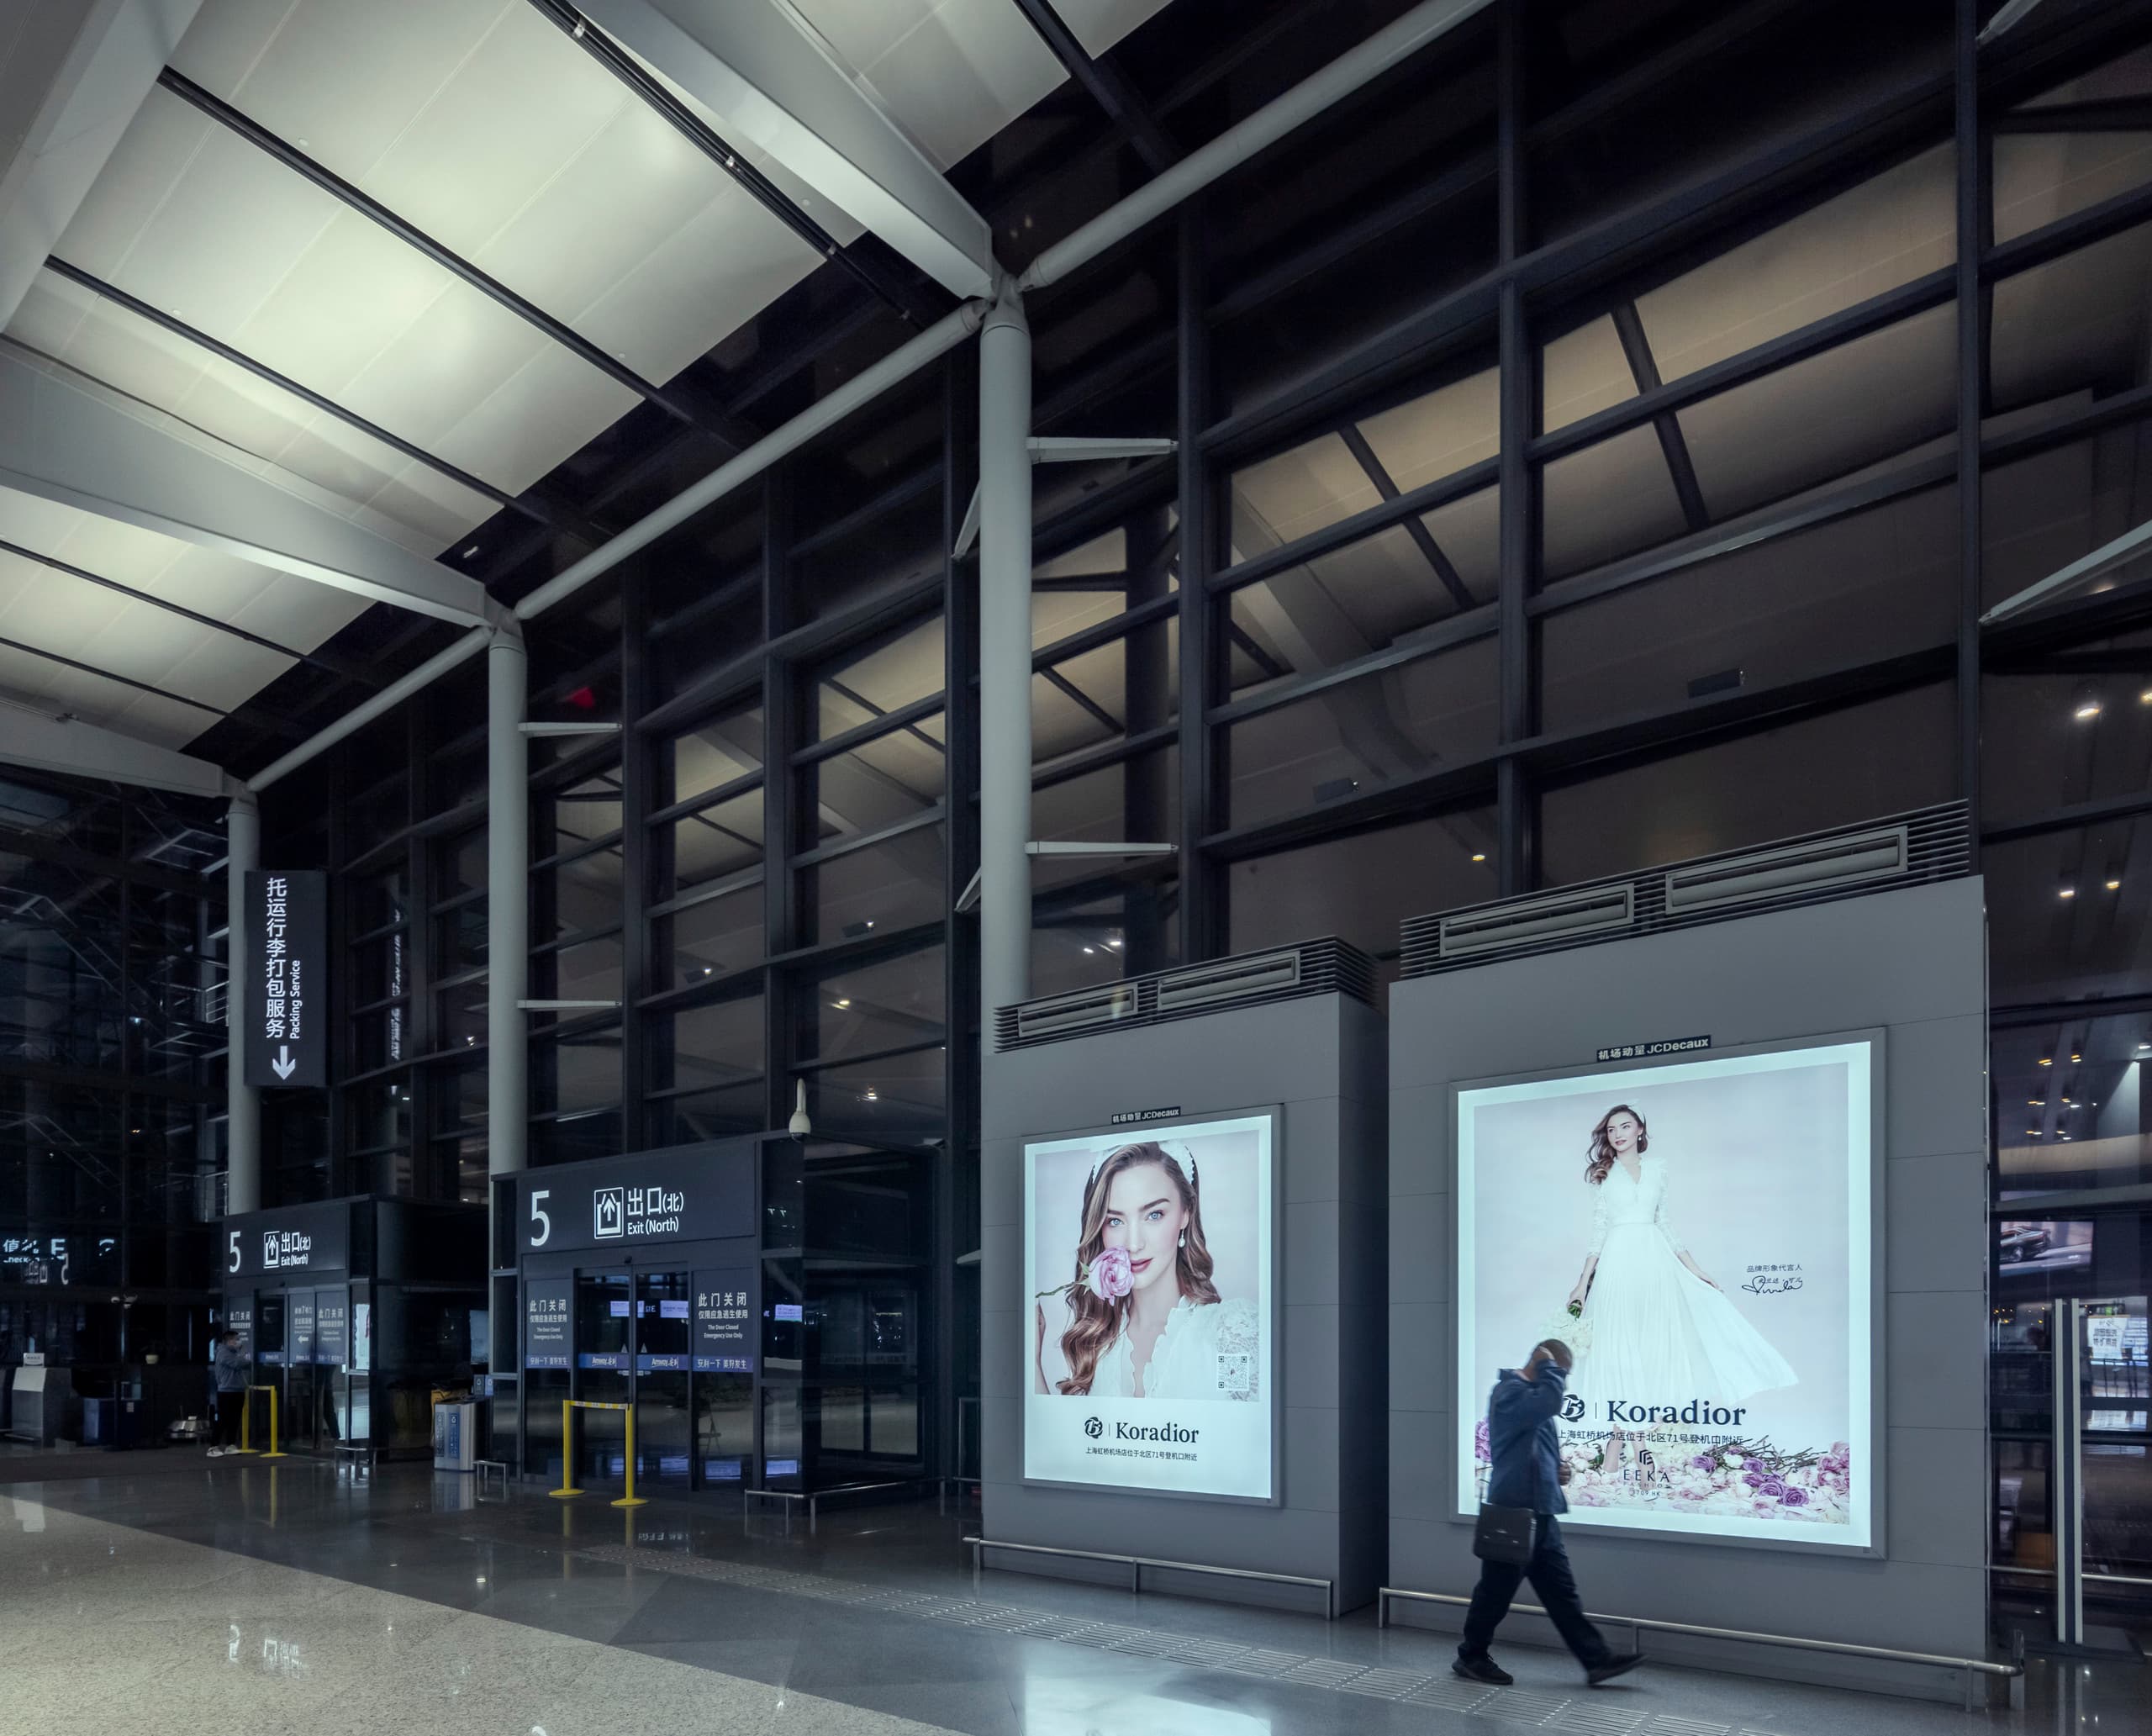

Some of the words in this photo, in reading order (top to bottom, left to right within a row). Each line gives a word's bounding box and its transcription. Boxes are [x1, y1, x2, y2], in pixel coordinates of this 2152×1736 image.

[266, 877, 287, 1039] 托运行李打包服务
[289, 959, 301, 998] Service
[289, 999, 303, 1040] Packing
[1597, 1044, 1645, 1061] 机场动量
[1647, 1037, 1709, 1055] JCDecaux
[1142, 1108, 1180, 1120] JCDecaux
[627, 1187, 684, 1216] 出口(北)
[530, 1190, 551, 1247] 5
[627, 1222, 645, 1236] Exit
[646, 1216, 679, 1236] (North)
[229, 1231, 241, 1274] 5
[281, 1231, 311, 1253] 出口(北)
[281, 1256, 290, 1267] Exit
[1747, 1264, 1802, 1273] 品牌形象代言人
[530, 1299, 567, 1312] 此门关闭
[698, 1291, 746, 1307] 此门关闭
[1606, 1398, 1747, 1426] Koradior
[1116, 1421, 1200, 1443] Koradior
[1554, 1429, 1743, 1446] 上海虹桥机场店位于北区71号登机口附近
[1085, 1446, 1198, 1462] 上海虹桥机场店位于北区71号登机口附近
[1623, 1469, 1670, 1483] EEKA
